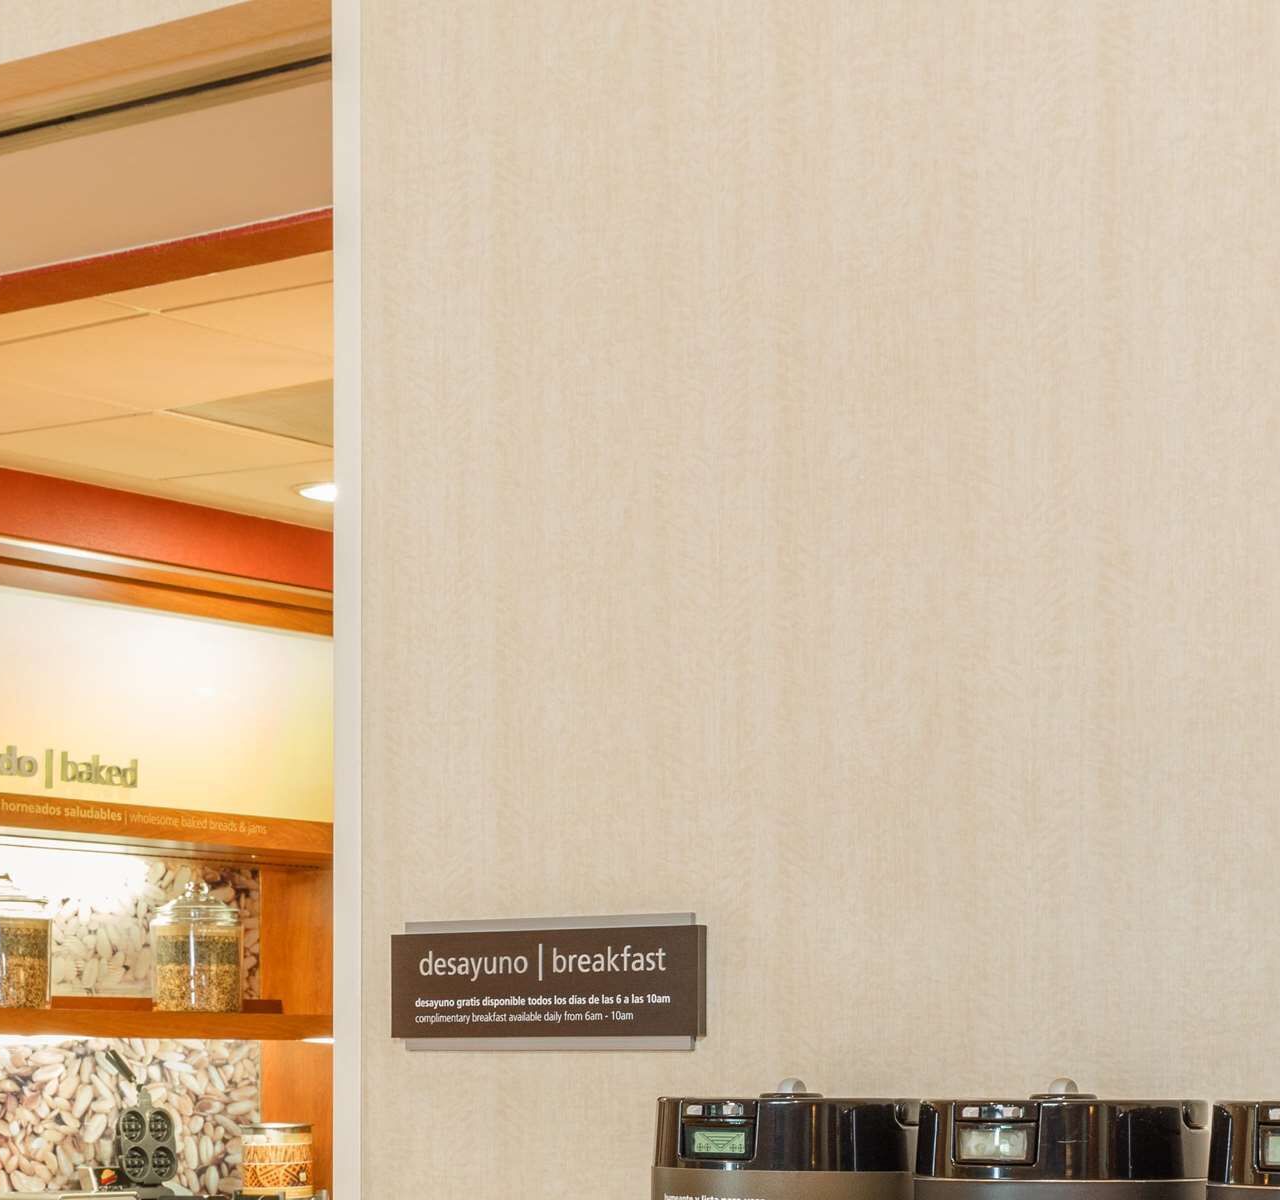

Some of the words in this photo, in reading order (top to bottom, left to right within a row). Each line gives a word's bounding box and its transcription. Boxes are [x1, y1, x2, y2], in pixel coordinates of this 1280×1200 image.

[60, 751, 138, 788] baked
[0, 800, 62, 817] horneados
[64, 806, 122, 822] saludables
[129, 812, 181, 828] wholesome
[181, 815, 208, 829] baked
[209, 818, 238, 832] breads
[419, 951, 528, 982] desayuno
[552, 945, 666, 973] breakfast
[415, 998, 454, 1009] desayuno
[456, 997, 480, 1009] gratis
[482, 996, 526, 1008] disponible
[528, 995, 552, 1005] todos
[554, 995, 567, 1005] los
[569, 995, 586, 1005] días
[588, 994, 600, 1004] de
[601, 994, 614, 1004] las
[616, 994, 622, 1004] 6
[623, 996, 630, 1004] a
[631, 993, 644, 1004] las
[646, 994, 671, 1003] 10am
[415, 1012, 470, 1024] complimentary
[472, 1012, 506, 1022] breakfast
[509, 1011, 542, 1022] available
[543, 1011, 562, 1023] daily
[564, 1011, 583, 1021] from
[585, 1011, 603, 1020] 6am
[612, 1011, 634, 1020] 10am
